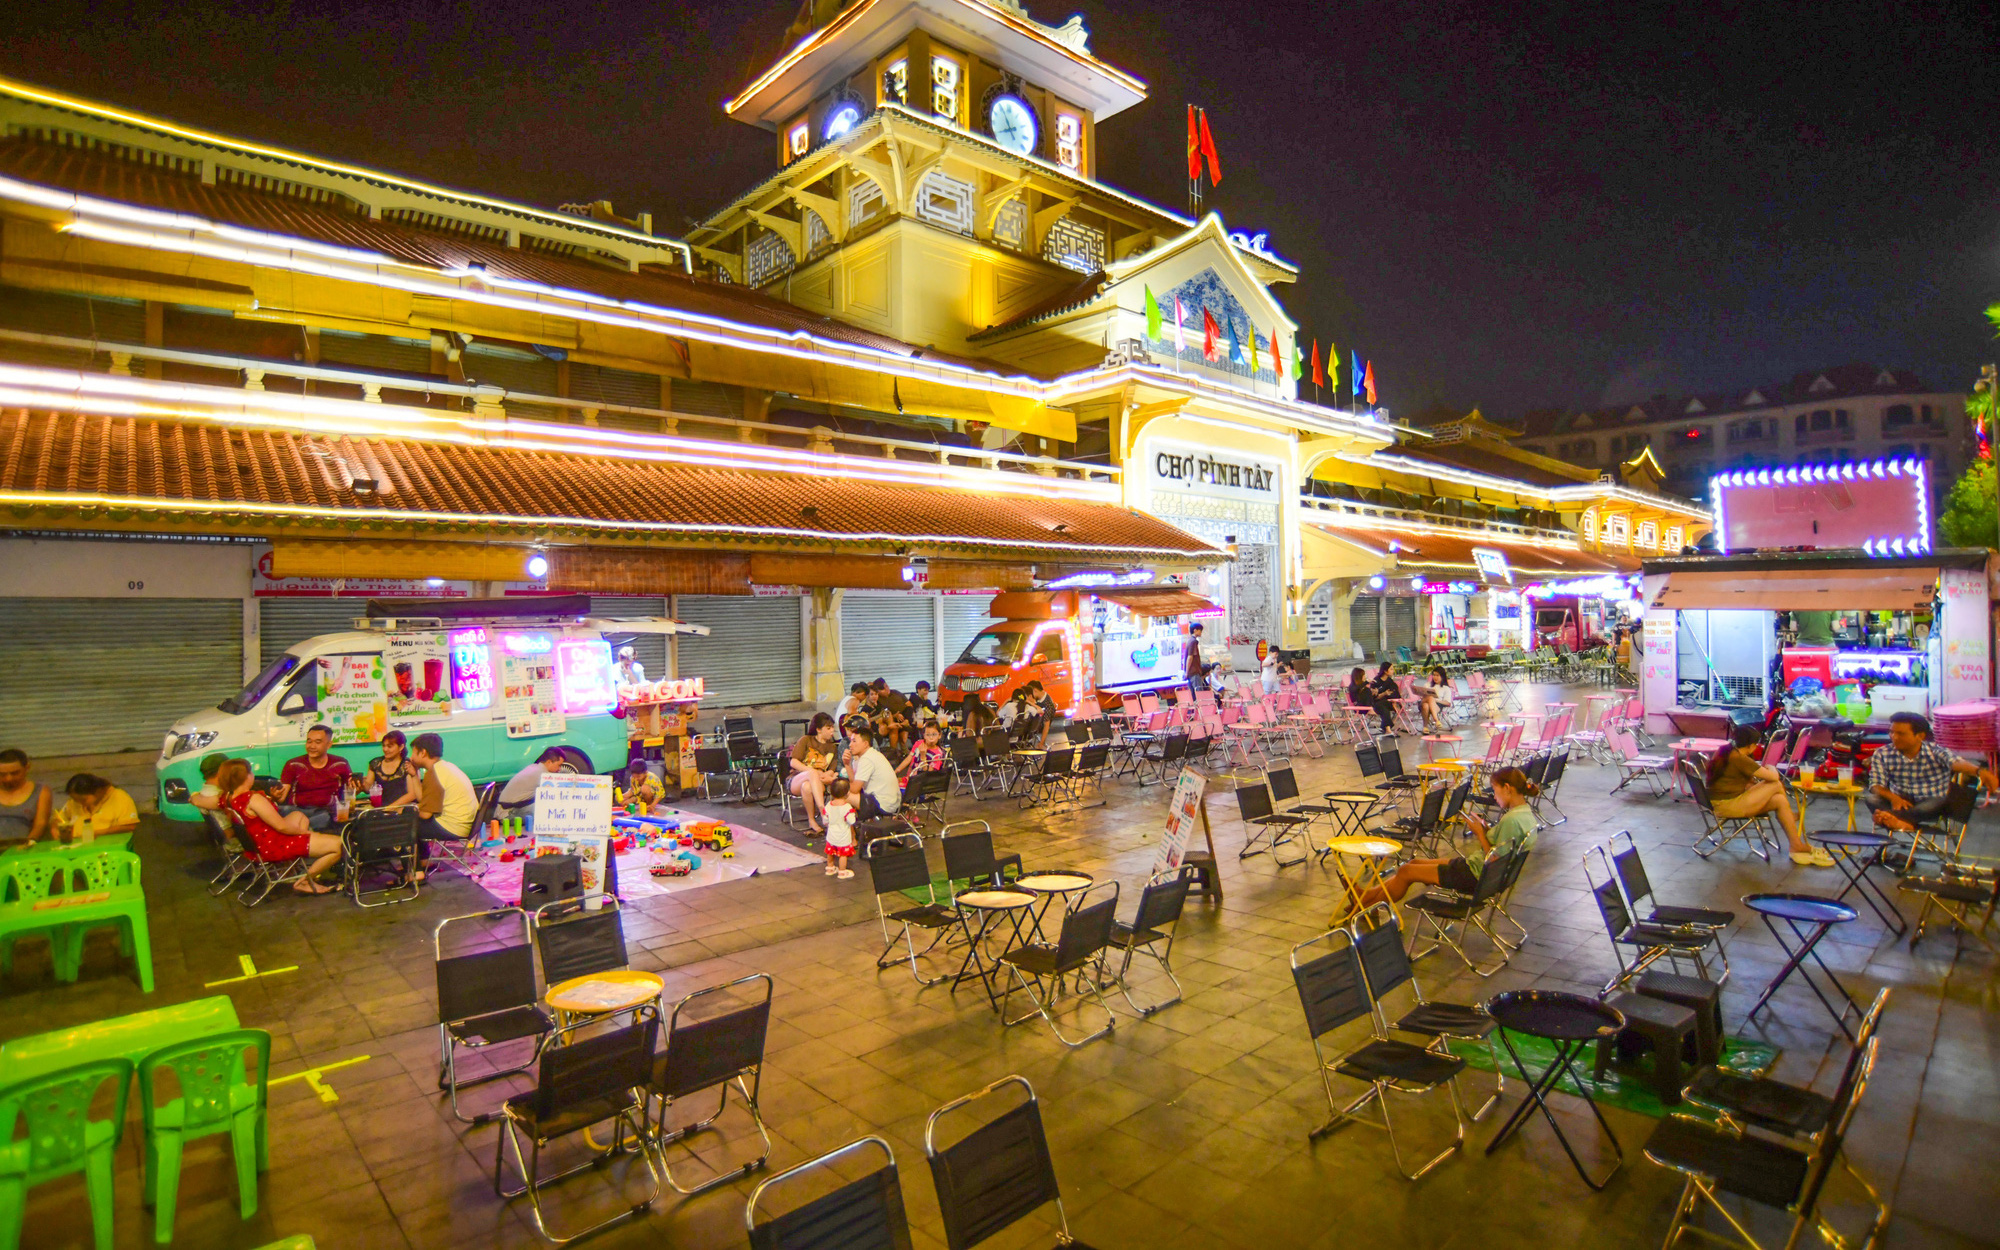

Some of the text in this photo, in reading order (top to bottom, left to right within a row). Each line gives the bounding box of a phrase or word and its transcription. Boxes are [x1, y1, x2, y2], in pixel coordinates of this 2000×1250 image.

[1157, 452, 1274, 492] CHỢ BÌNH TÂY
[128, 580, 144, 590] 09
[351, 663, 369, 671] BẠN
[540, 790, 555, 800] Khu
[573, 808, 588, 819] Phí
